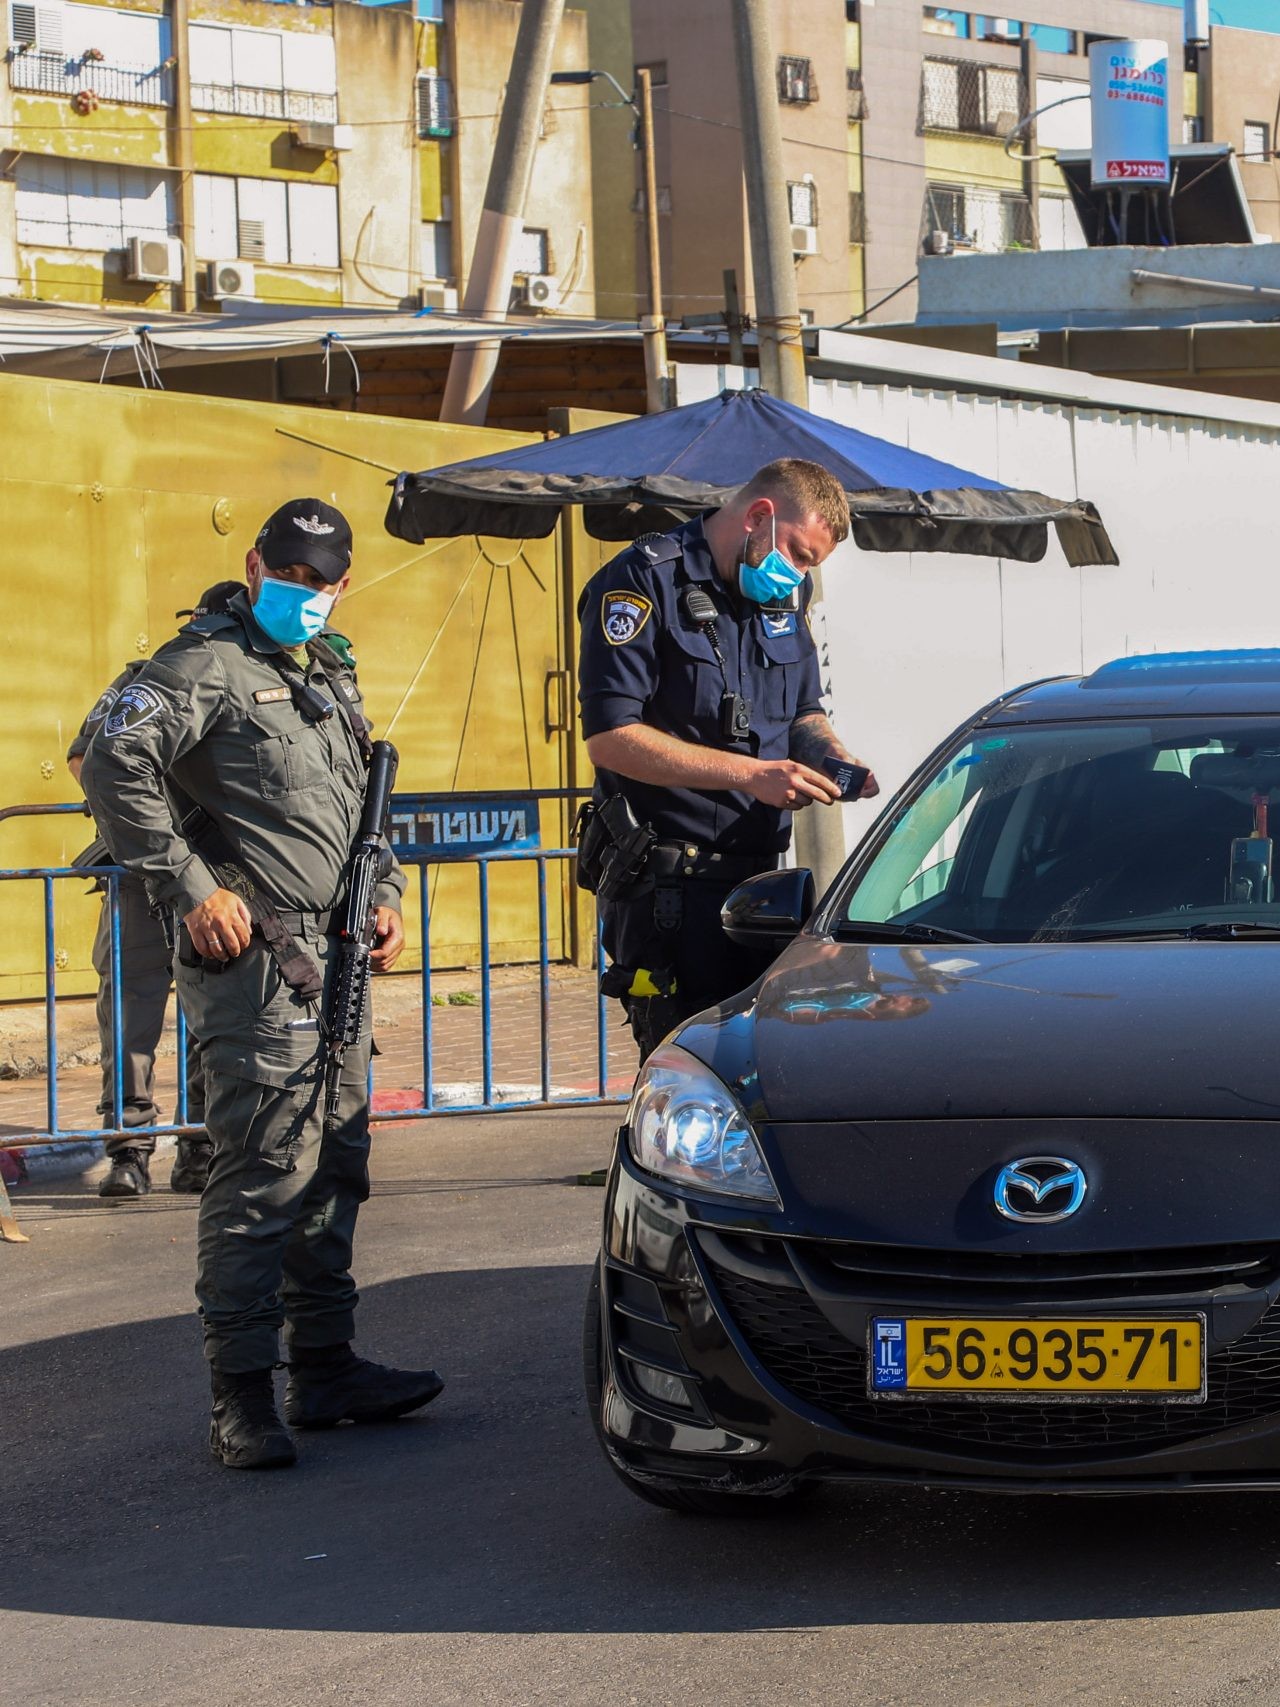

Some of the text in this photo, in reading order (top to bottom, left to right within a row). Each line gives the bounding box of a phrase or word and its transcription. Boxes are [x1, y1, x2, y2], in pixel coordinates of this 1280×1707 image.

[391, 810, 527, 846] משטרה
[881, 1341, 899, 1367] IL
[876, 1367, 904, 1375] ישראל
